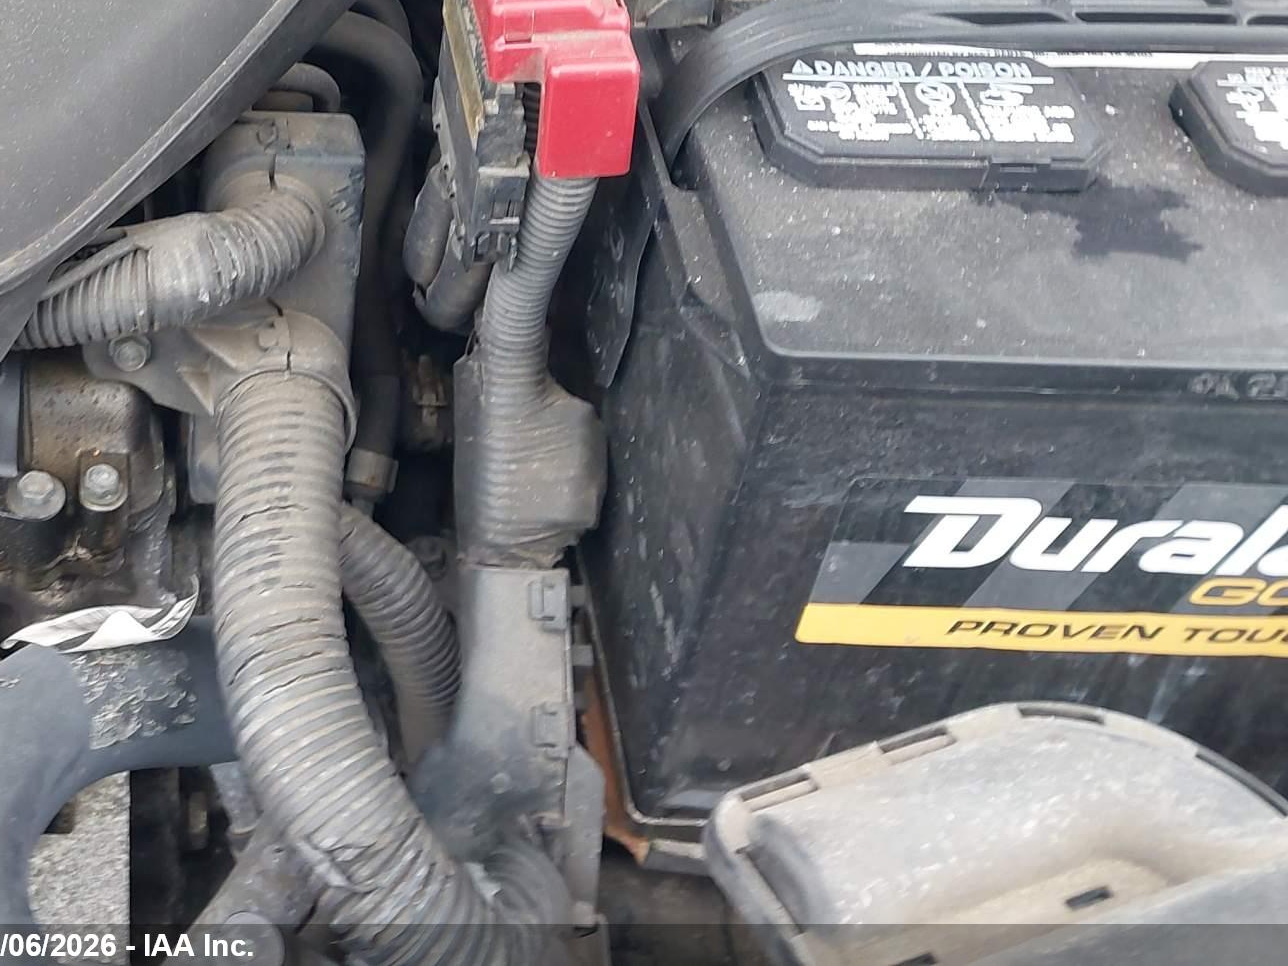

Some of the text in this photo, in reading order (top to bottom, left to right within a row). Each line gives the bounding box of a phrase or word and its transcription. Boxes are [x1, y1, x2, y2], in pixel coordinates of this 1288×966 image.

[813, 60, 915, 79] DANGER
[938, 62, 1034, 80] POISON
[946, 619, 1166, 642] PROVEN
